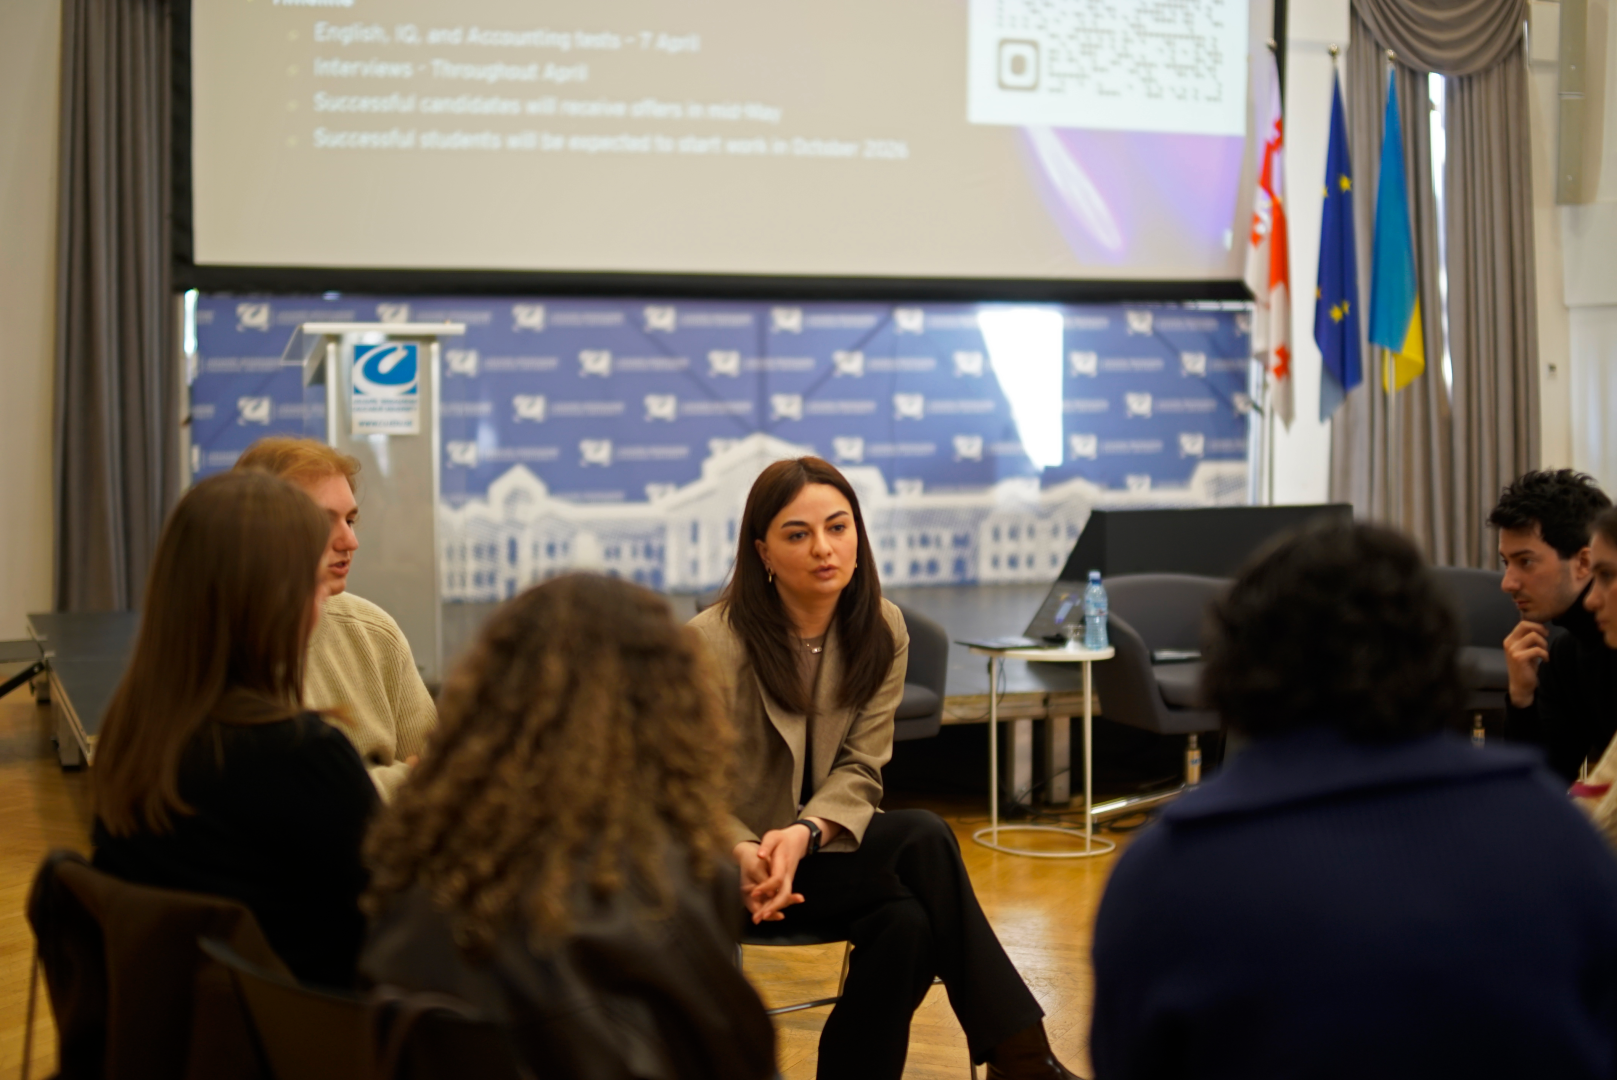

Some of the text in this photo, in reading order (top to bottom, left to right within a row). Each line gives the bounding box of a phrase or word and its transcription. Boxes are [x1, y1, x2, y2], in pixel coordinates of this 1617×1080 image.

[315, 21, 390, 46] English,
[427, 27, 462, 45] and
[468, 27, 570, 50] Accounting
[575, 31, 621, 49] tests
[638, 31, 652, 48] 7
[656, 34, 700, 53] April
[314, 58, 413, 77] Interviews
[433, 59, 538, 83] Throughout
[544, 64, 588, 83] April
[313, 92, 415, 113] Successful
[421, 95, 520, 115] candidates
[527, 97, 556, 115] will
[561, 99, 627, 117] receive
[631, 99, 683, 119] offers
[687, 101, 704, 119] in
[313, 127, 415, 149] Successful
[421, 131, 502, 150] students
[508, 132, 537, 150] will
[542, 133, 564, 150] be
[569, 134, 651, 155] expected
[654, 136, 674, 152] to
[679, 137, 722, 154] start
[727, 138, 768, 154] work
[773, 139, 788, 155] in
[792, 137, 858, 157] October
